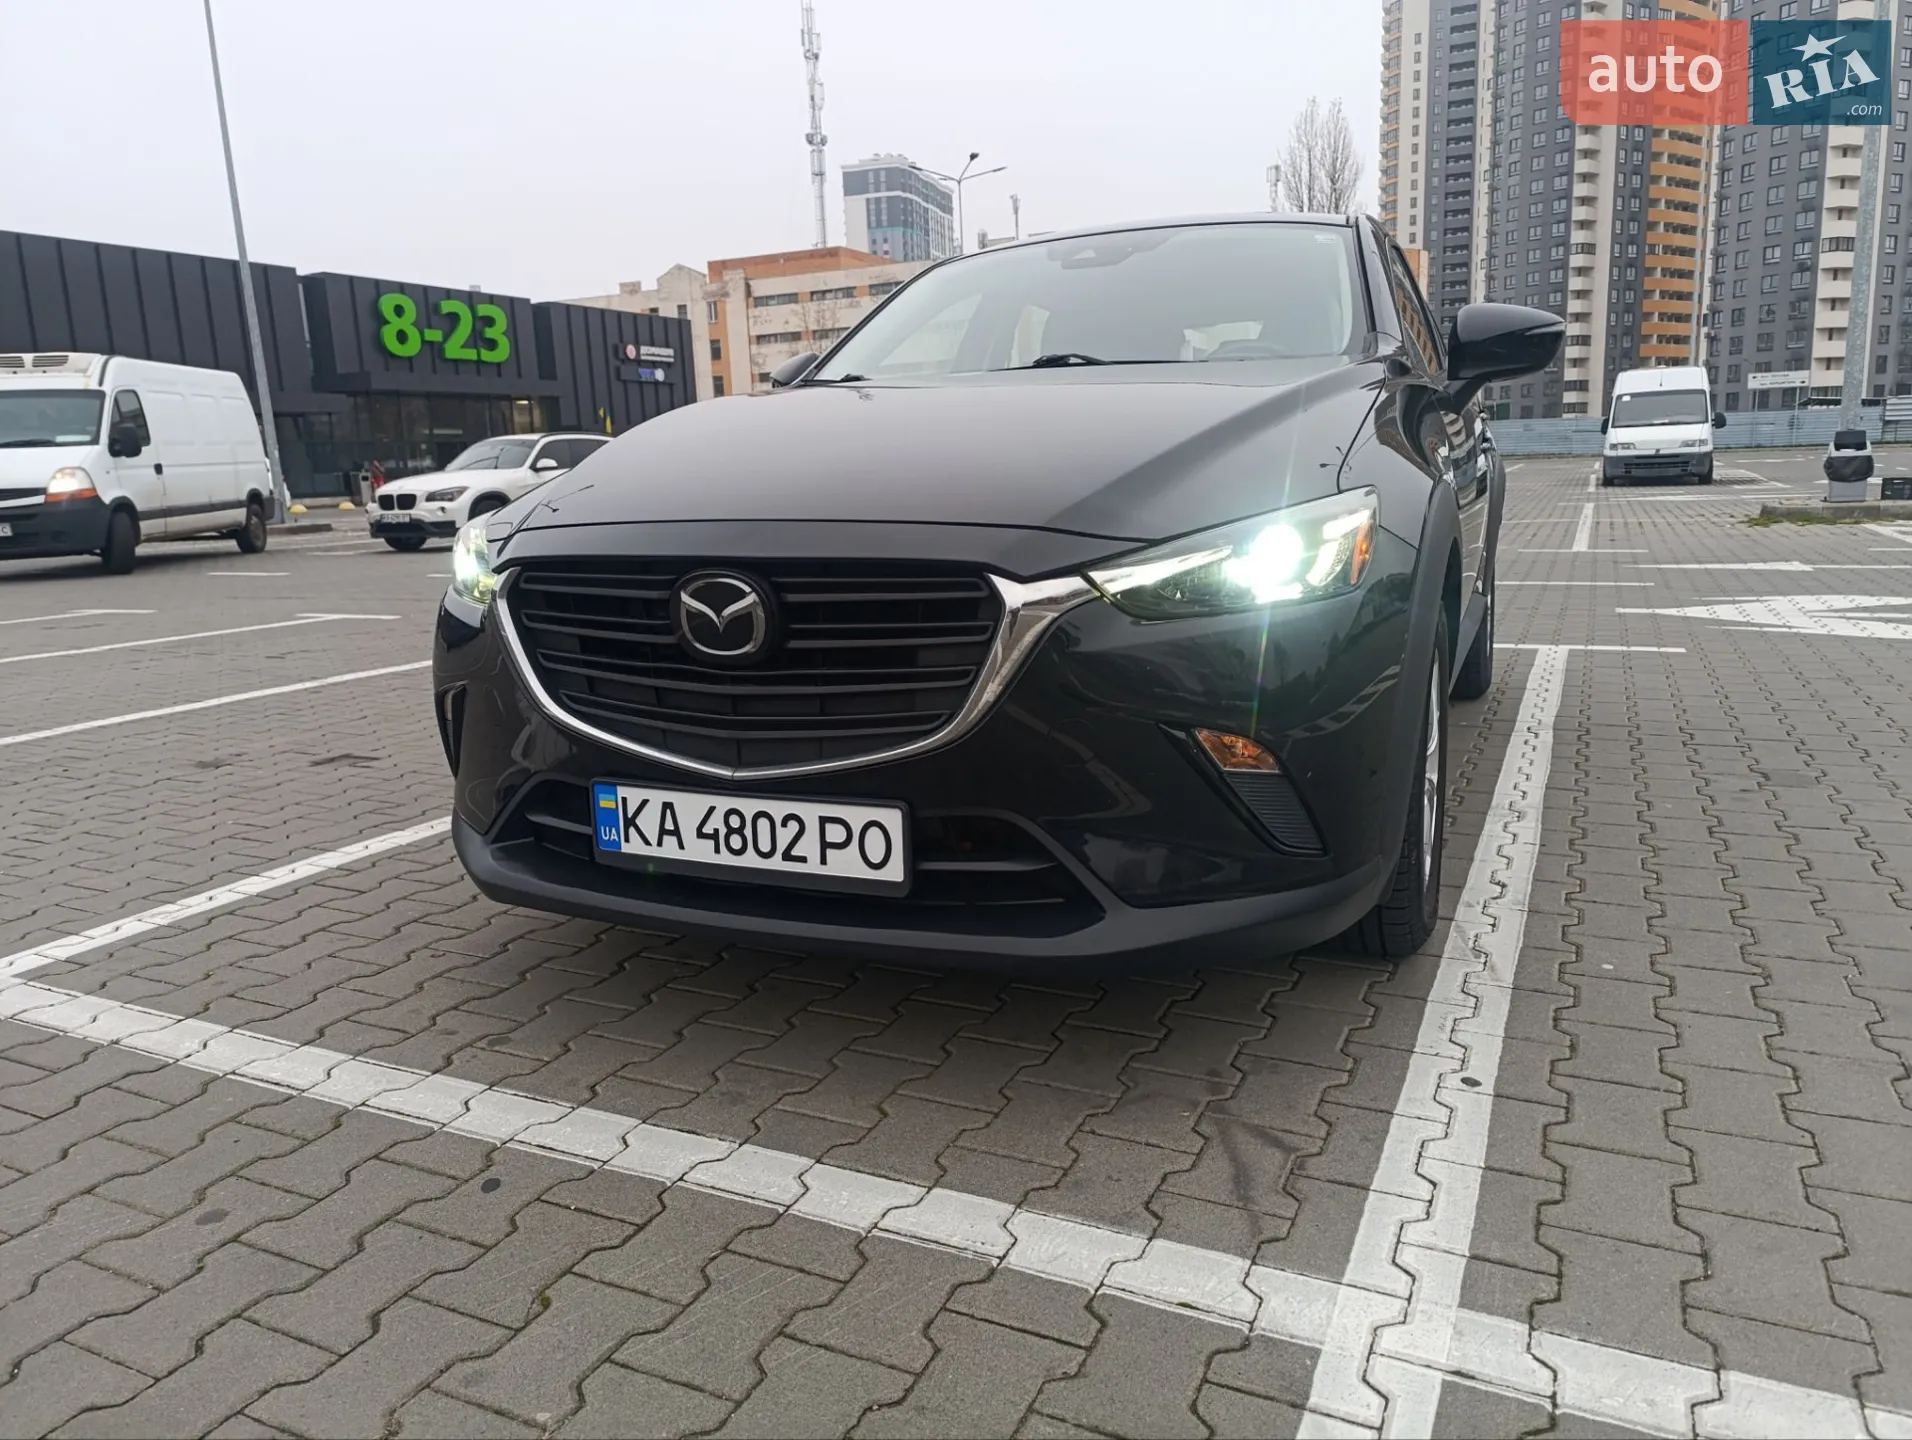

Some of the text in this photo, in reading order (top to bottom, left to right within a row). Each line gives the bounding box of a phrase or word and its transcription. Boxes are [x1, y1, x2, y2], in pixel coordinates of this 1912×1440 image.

[378, 292, 511, 363] 8-23
[601, 826, 618, 842] UA
[621, 796, 892, 871] KA 4802 PO
